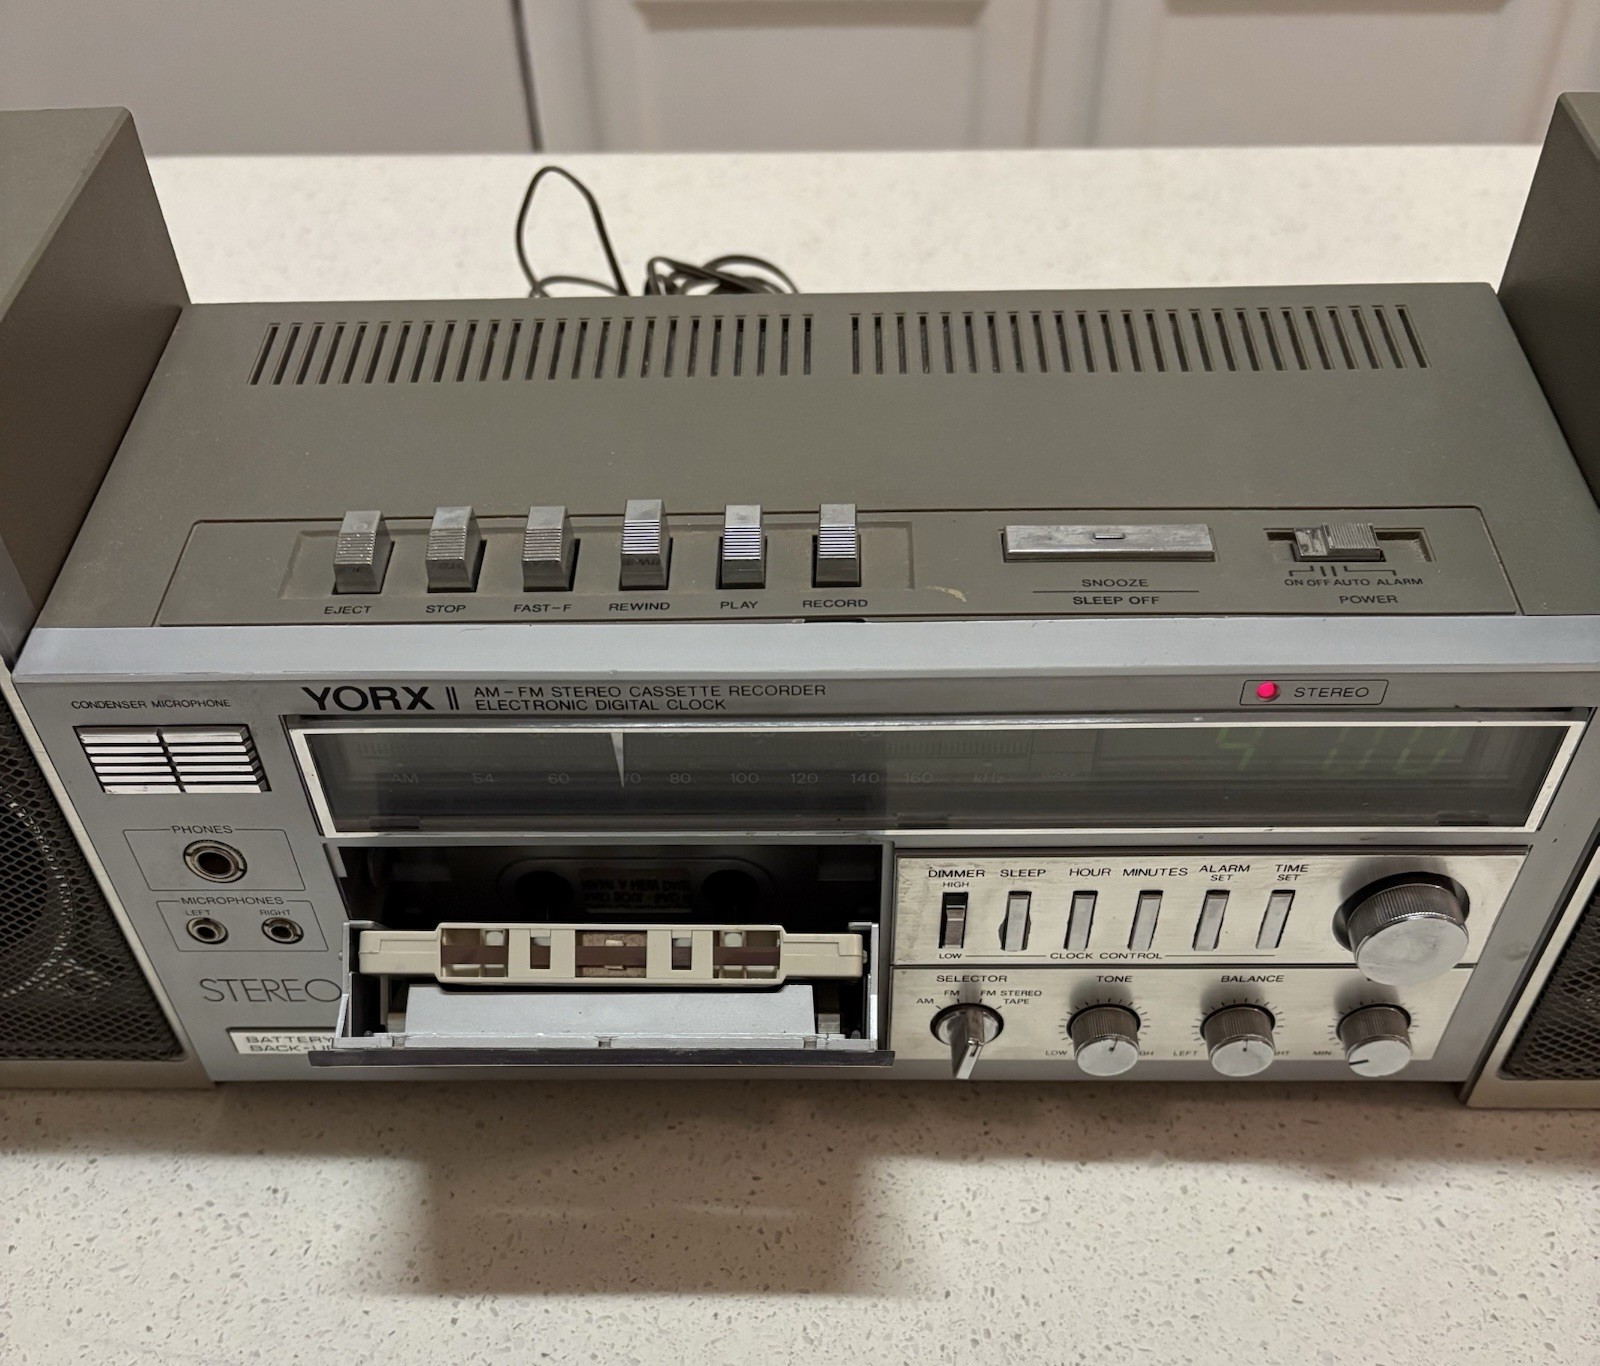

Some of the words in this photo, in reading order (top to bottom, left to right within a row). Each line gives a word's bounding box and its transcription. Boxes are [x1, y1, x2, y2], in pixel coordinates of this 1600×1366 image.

[1082, 578, 1149, 588] SNOOZE
[1284, 577, 1304, 587] ON
[1307, 577, 1330, 587] OFF
[1333, 577, 1370, 587] AUTO
[1377, 576, 1423, 587] ALARM
[802, 599, 868, 609] RECORD
[1073, 596, 1124, 606] SLEEP
[1129, 596, 1160, 606] OFF
[1339, 594, 1398, 604] POWER
[324, 605, 372, 615] EJECT
[426, 604, 466, 614] STOP
[513, 603, 572, 613] FAST-F
[608, 602, 671, 612] REWIND
[720, 600, 759, 610] PLAY
[551, 685, 621, 698] STEREO
[628, 685, 723, 698] CASSETTE
[728, 684, 826, 697] RECORDER
[1293, 686, 1370, 699] STEREO
[71, 699, 148, 710] CONDENSER
[152, 698, 231, 709] MICROPHONE
[300, 686, 435, 712] YORX
[475, 698, 588, 712] ELECTRONIC
[596, 698, 661, 711] DIGITAL
[666, 698, 727, 711] CLOCK
[390, 773, 419, 784] AM
[472, 773, 495, 784] 54
[547, 773, 570, 784] 60
[669, 773, 691, 784] 80
[730, 773, 760, 784] 100
[790, 773, 819, 784] 120
[850, 773, 880, 784] 140
[904, 772, 934, 784] 160
[171, 825, 233, 834] PHONES
[928, 869, 986, 878] DIMMER
[1000, 868, 1046, 877] SLEEP
[1069, 867, 1112, 877] HOUR
[1122, 867, 1188, 877] MINUTES
[1199, 864, 1250, 873] ALARM
[1275, 864, 1309, 873] TIME
[1210, 874, 1233, 882] SET
[1277, 874, 1301, 882] SET
[181, 896, 284, 905] MICROPHONES
[938, 952, 963, 960] LOW
[1050, 952, 1093, 960] CLOCK
[1099, 952, 1163, 960] CONTROL
[936, 975, 1008, 984] SELECTOR
[1096, 975, 1133, 983] TONE
[1220, 975, 1285, 983] BALANCE
[200, 978, 342, 1002] STEREO
[1000, 989, 1042, 997] STEREO
[246, 1035, 333, 1043] BATTERY
